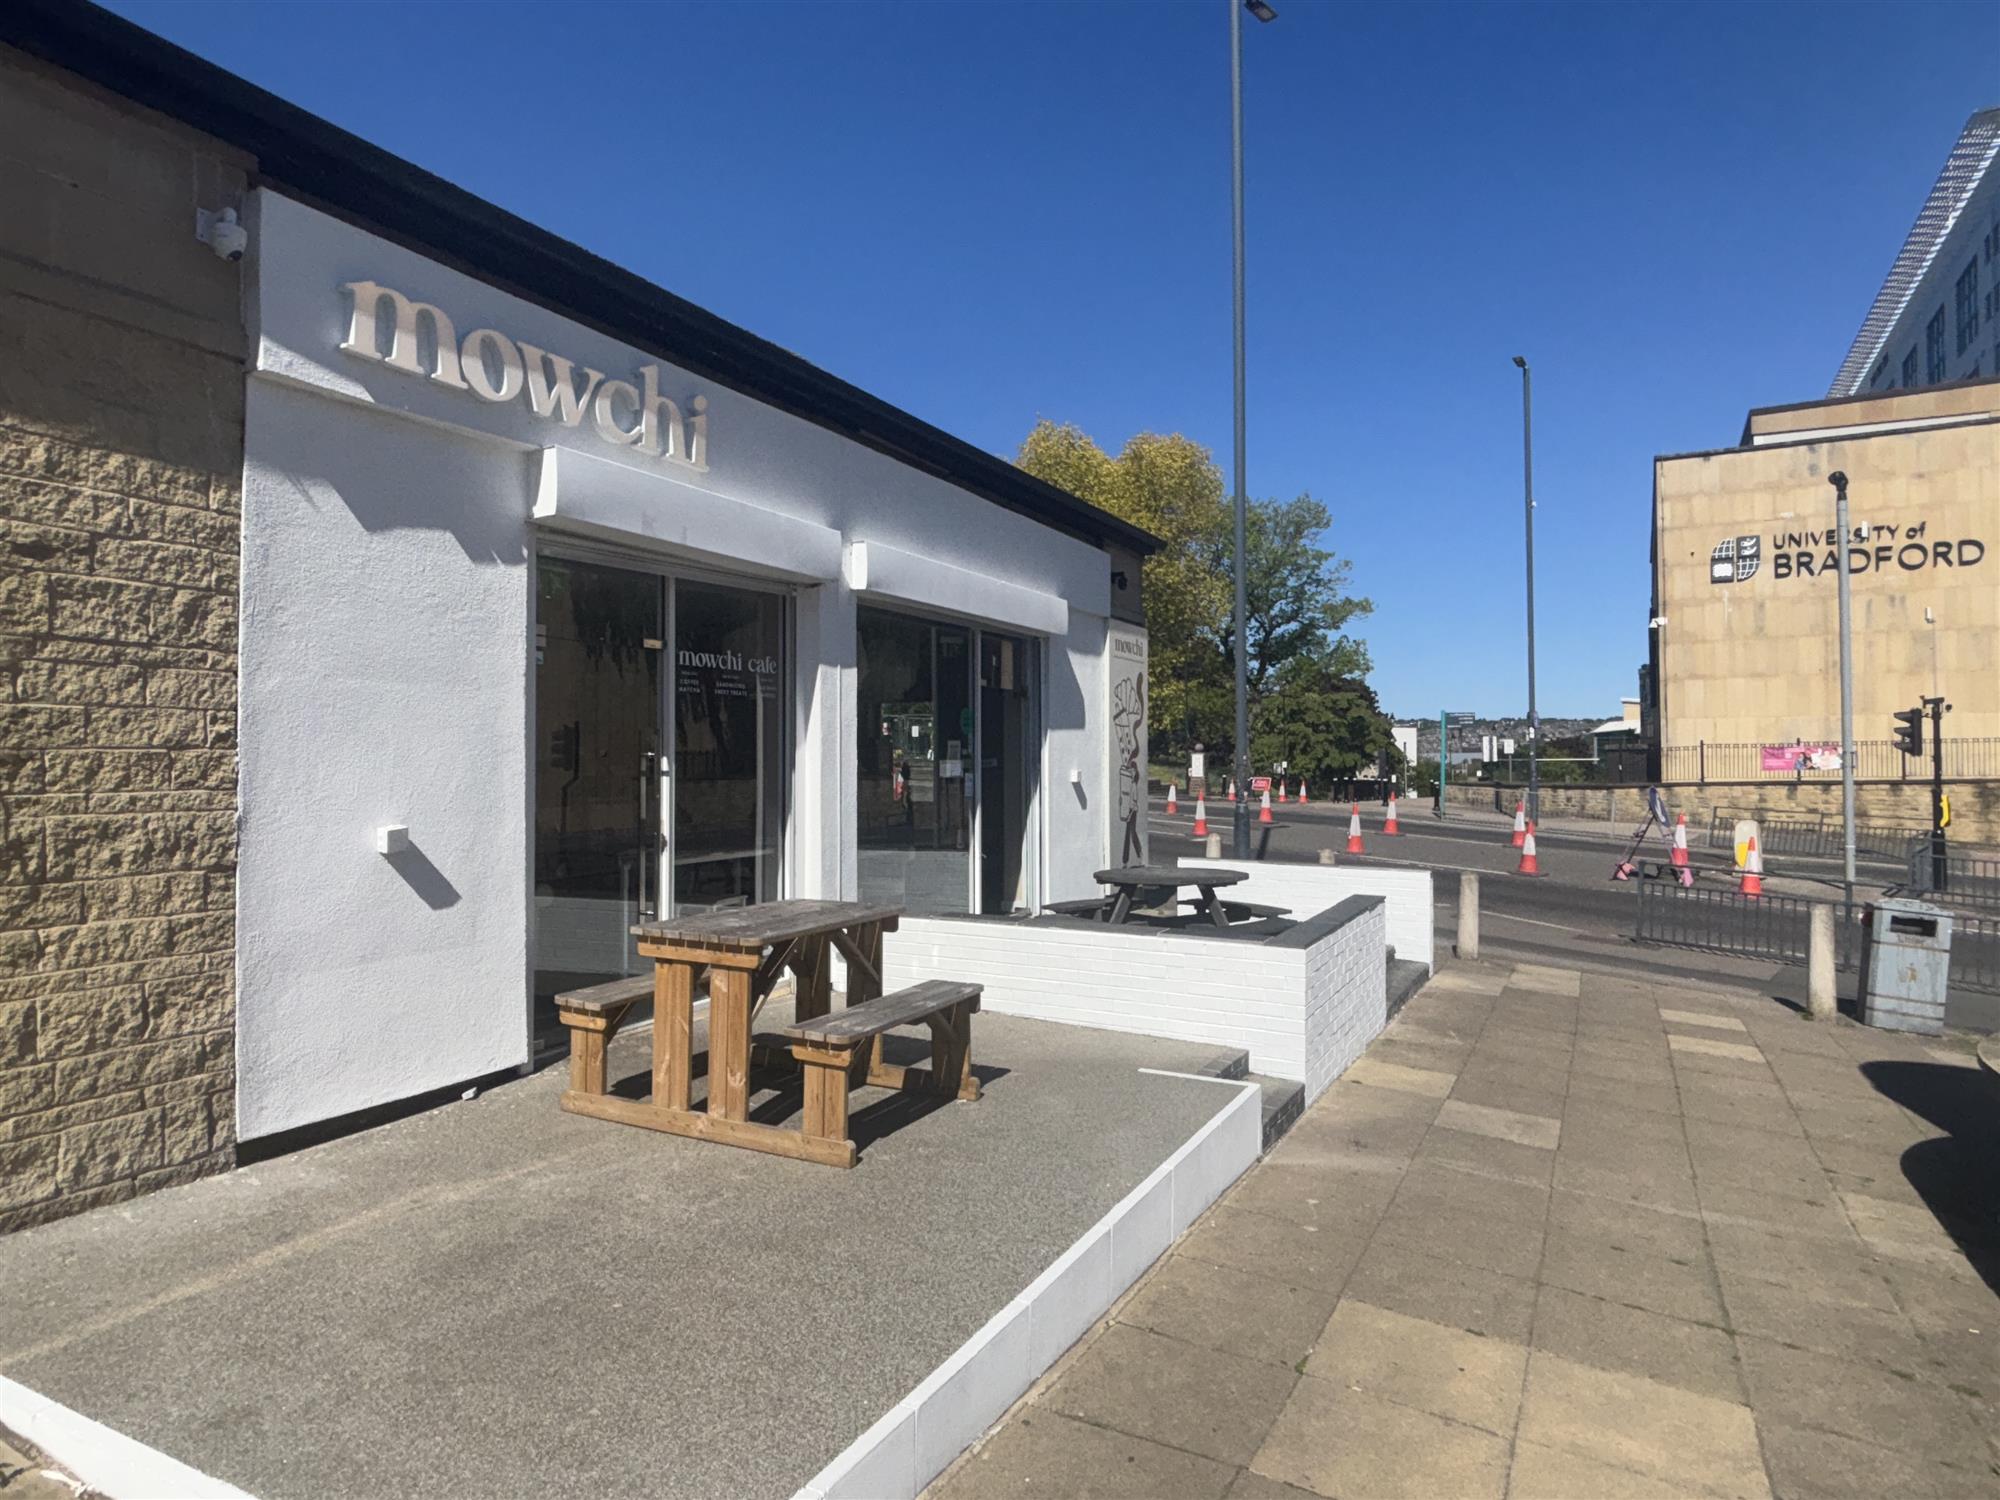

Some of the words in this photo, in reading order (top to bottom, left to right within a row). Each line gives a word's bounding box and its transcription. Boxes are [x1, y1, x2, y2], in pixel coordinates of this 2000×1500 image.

[339, 280, 710, 473] mowchi
[1773, 524, 1899, 549] UNIVESTY
[1905, 520, 1927, 540] of
[1774, 539, 1985, 579] BRADFORD
[679, 650, 742, 671] mowchi
[1114, 638, 1143, 656] mowchi
